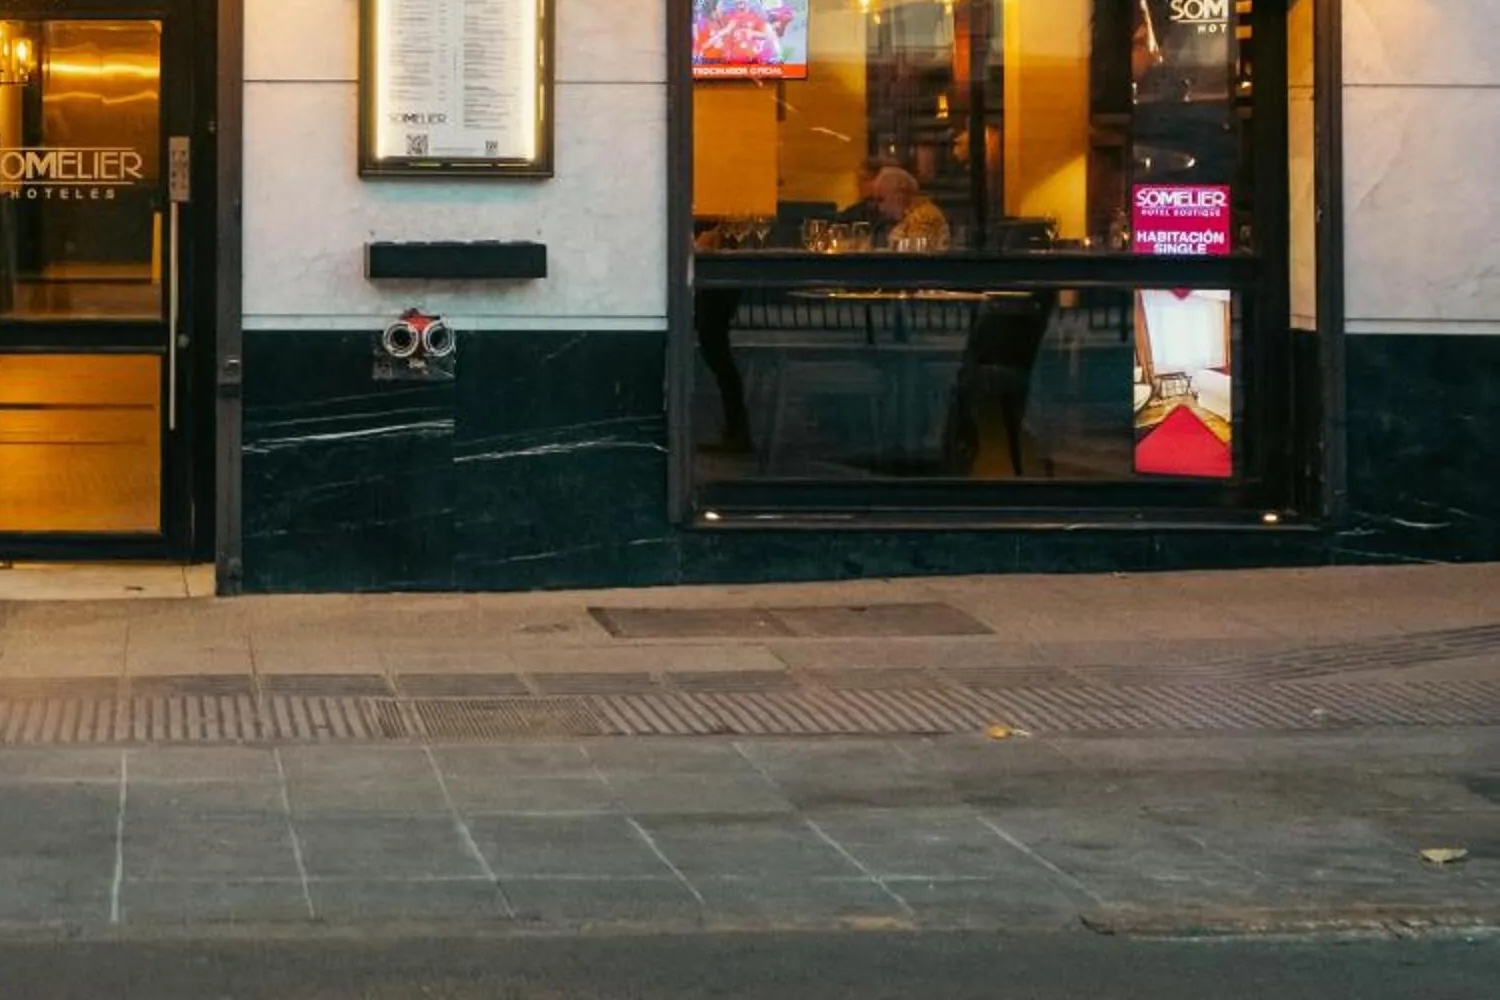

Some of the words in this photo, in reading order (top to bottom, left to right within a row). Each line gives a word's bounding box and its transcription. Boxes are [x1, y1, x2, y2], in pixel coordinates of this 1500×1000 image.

[11, 188, 115, 199] HOTELES
[1136, 189, 1228, 208] SOMELIER
[1137, 229, 1225, 245] HABITACIÓN
[1154, 243, 1207, 255] SINGLE
